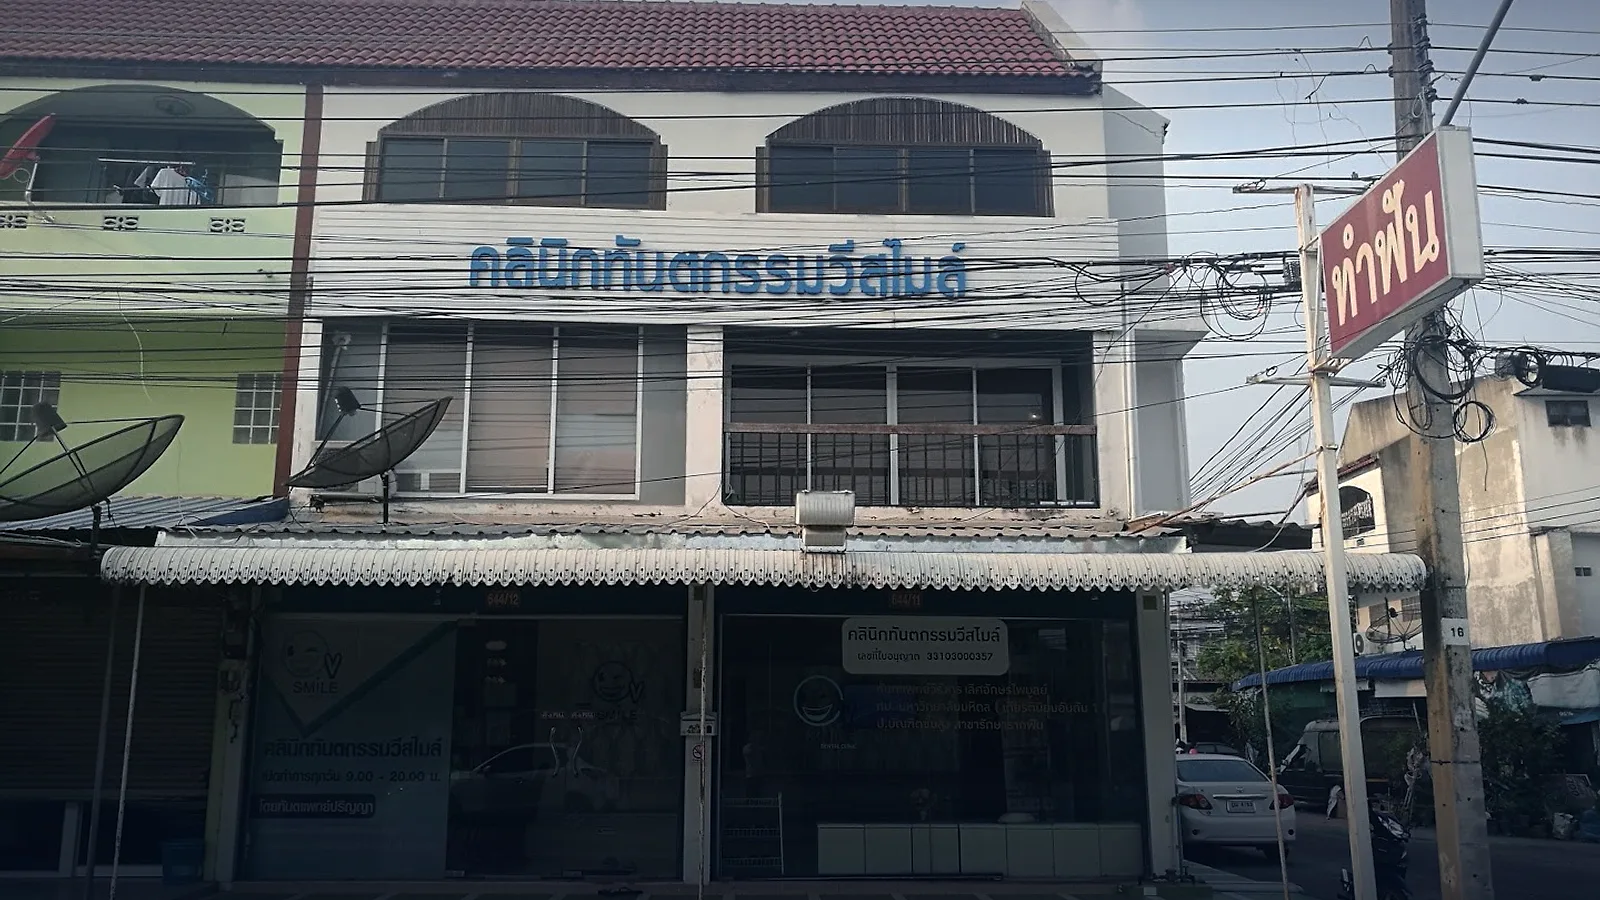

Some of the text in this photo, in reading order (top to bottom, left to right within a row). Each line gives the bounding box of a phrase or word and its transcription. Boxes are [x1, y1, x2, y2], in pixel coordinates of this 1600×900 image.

[1332, 179, 1440, 327] ทำฟัน
[469, 235, 967, 300] คลินิกทันตกรรมวีสไมล์
[847, 624, 1000, 643] คลินิกทันตกรรมวีสไมล์
[1450, 626, 1465, 638] 16
[263, 736, 442, 758] คลินิกทันตกรรมวีสไมล์
[345, 770, 374, 783] 9.00
[389, 770, 425, 783] 20.00
